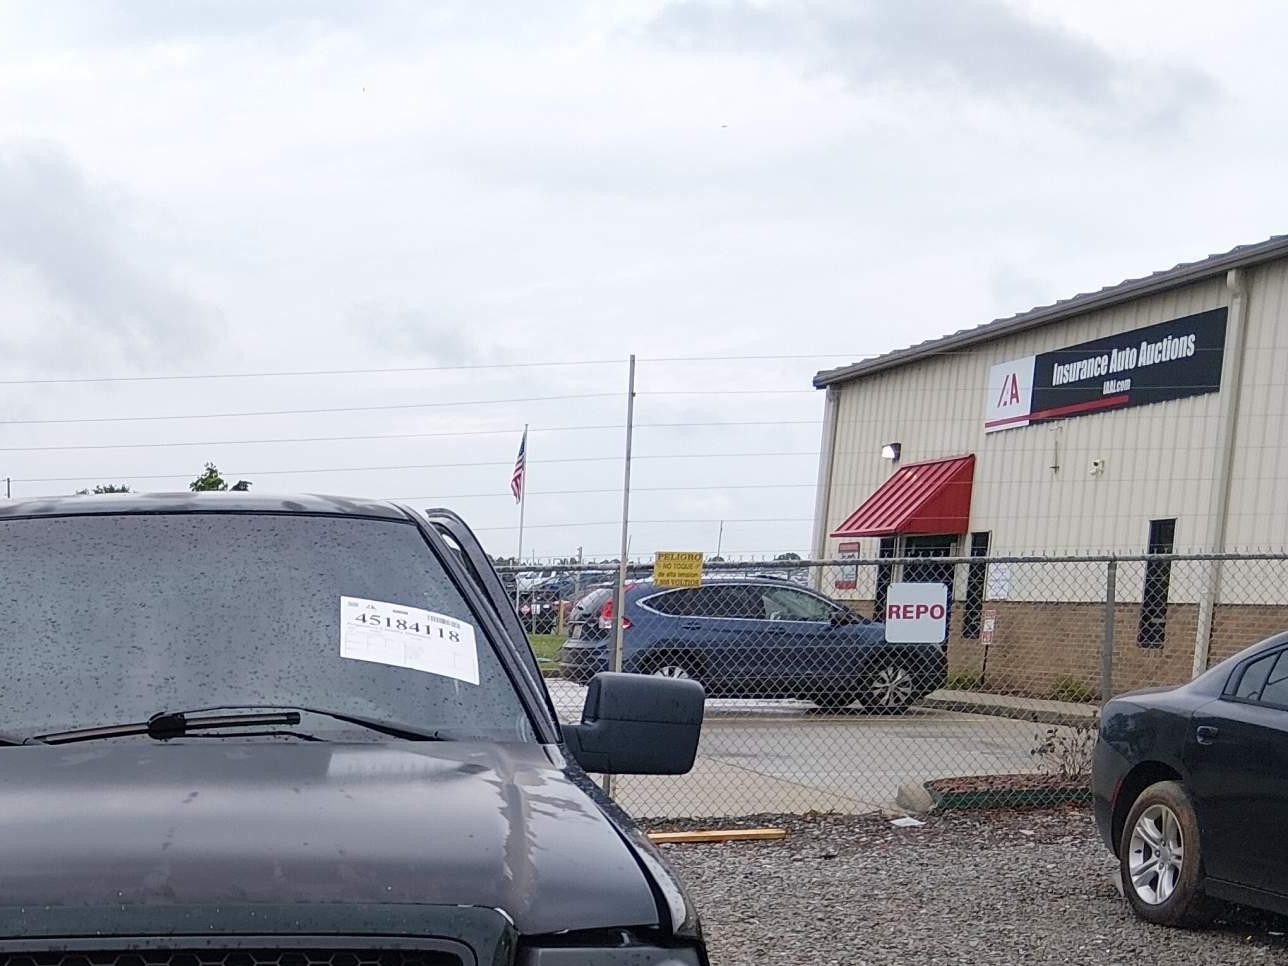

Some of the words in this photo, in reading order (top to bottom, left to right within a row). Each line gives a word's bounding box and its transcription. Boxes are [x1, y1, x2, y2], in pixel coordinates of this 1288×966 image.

[1052, 354, 1108, 386] Insurance
[1109, 346, 1138, 374] Auto
[1138, 333, 1196, 368] Auctions
[657, 553, 702, 561] PELIGRO
[888, 604, 945, 620] REPO
[355, 612, 461, 643] 45184118
